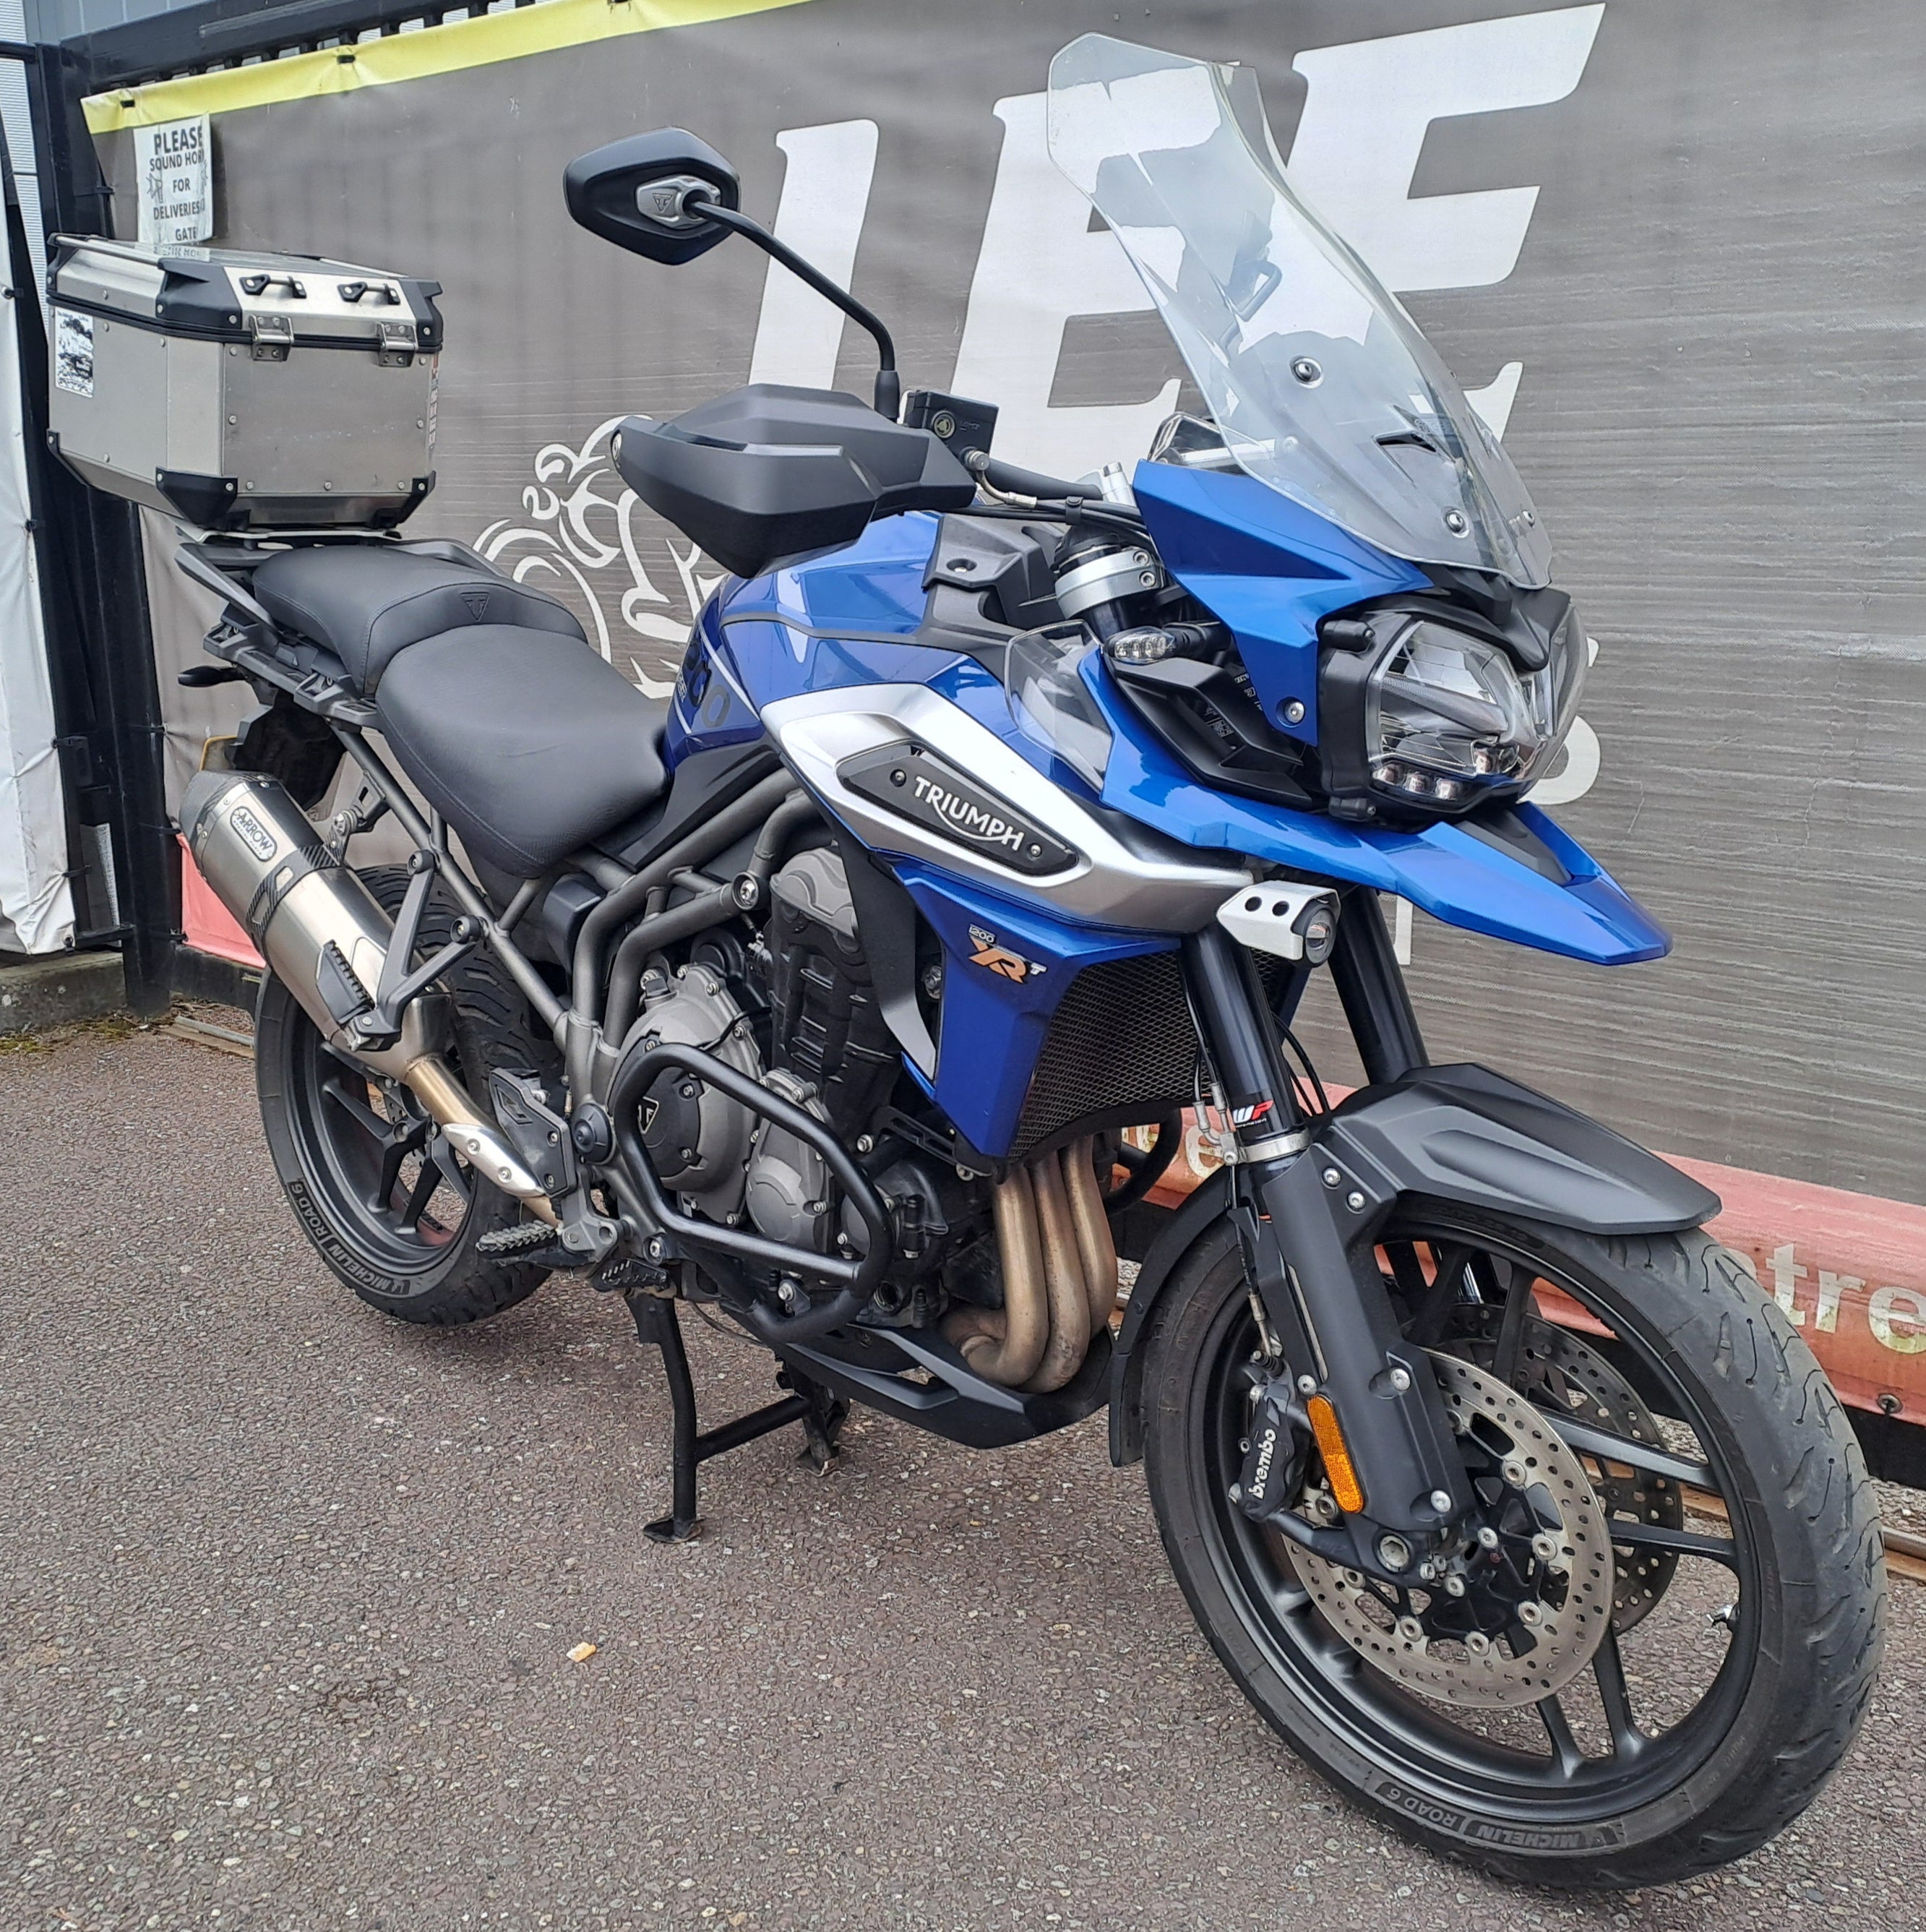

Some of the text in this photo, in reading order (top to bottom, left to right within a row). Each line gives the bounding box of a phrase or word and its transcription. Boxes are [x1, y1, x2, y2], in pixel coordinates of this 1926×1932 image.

[153, 125, 202, 155] PLEASE
[150, 154, 182, 172] SOUND
[173, 177, 191, 193] FOR
[153, 200, 199, 220] DELIVERIES
[175, 226, 197, 241] GATE
[914, 776, 1025, 851] TRIUMPH
[236, 812, 273, 851] ARROW
[968, 926, 995, 943] 1200
[1233, 1099, 1274, 1123] WP
[298, 1198, 327, 1239] ROAD
[328, 1243, 392, 1291] MICHELIN
[1248, 1428, 1276, 1500] brembo
[1403, 1795, 1459, 1828] ROAD
[1476, 1824, 1580, 1848] MICHELIN
